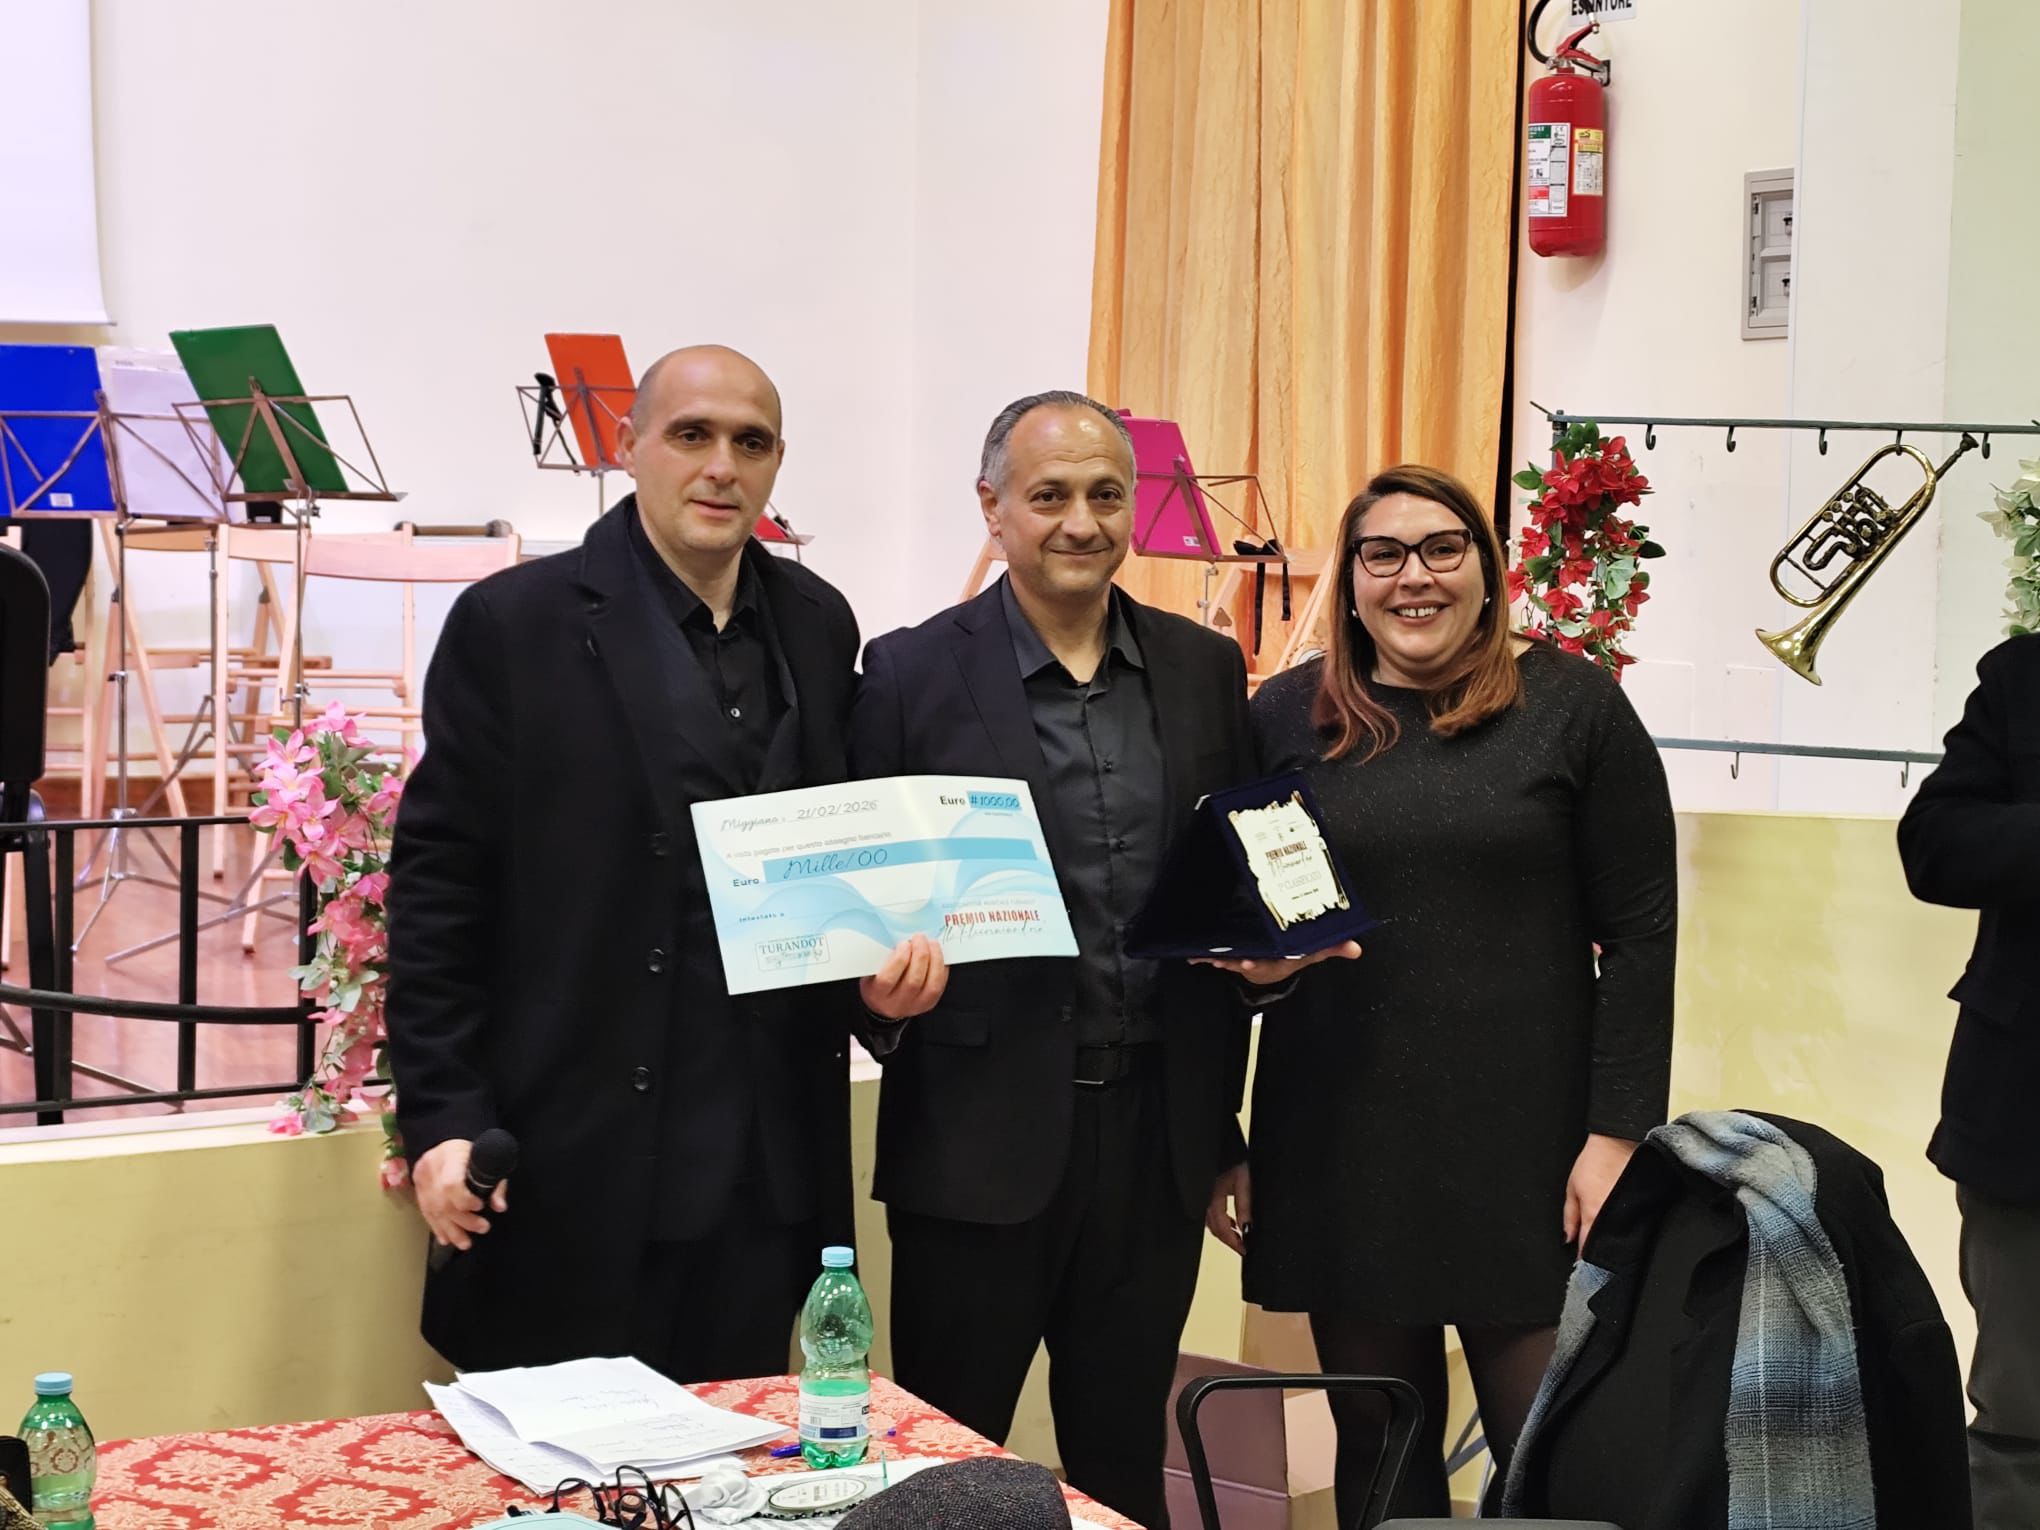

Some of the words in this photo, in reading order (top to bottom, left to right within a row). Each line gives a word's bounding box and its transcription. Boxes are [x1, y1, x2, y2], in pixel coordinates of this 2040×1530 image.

[1572, 0, 1633, 16] ESINTORE
[940, 795, 965, 805] Euro
[797, 799, 879, 820] 21/02/2026
[733, 876, 760, 887] Euro
[944, 911, 986, 927] PREMIO
[988, 909, 1041, 923] NAZIONALE
[758, 935, 825, 955] TURANDOT
